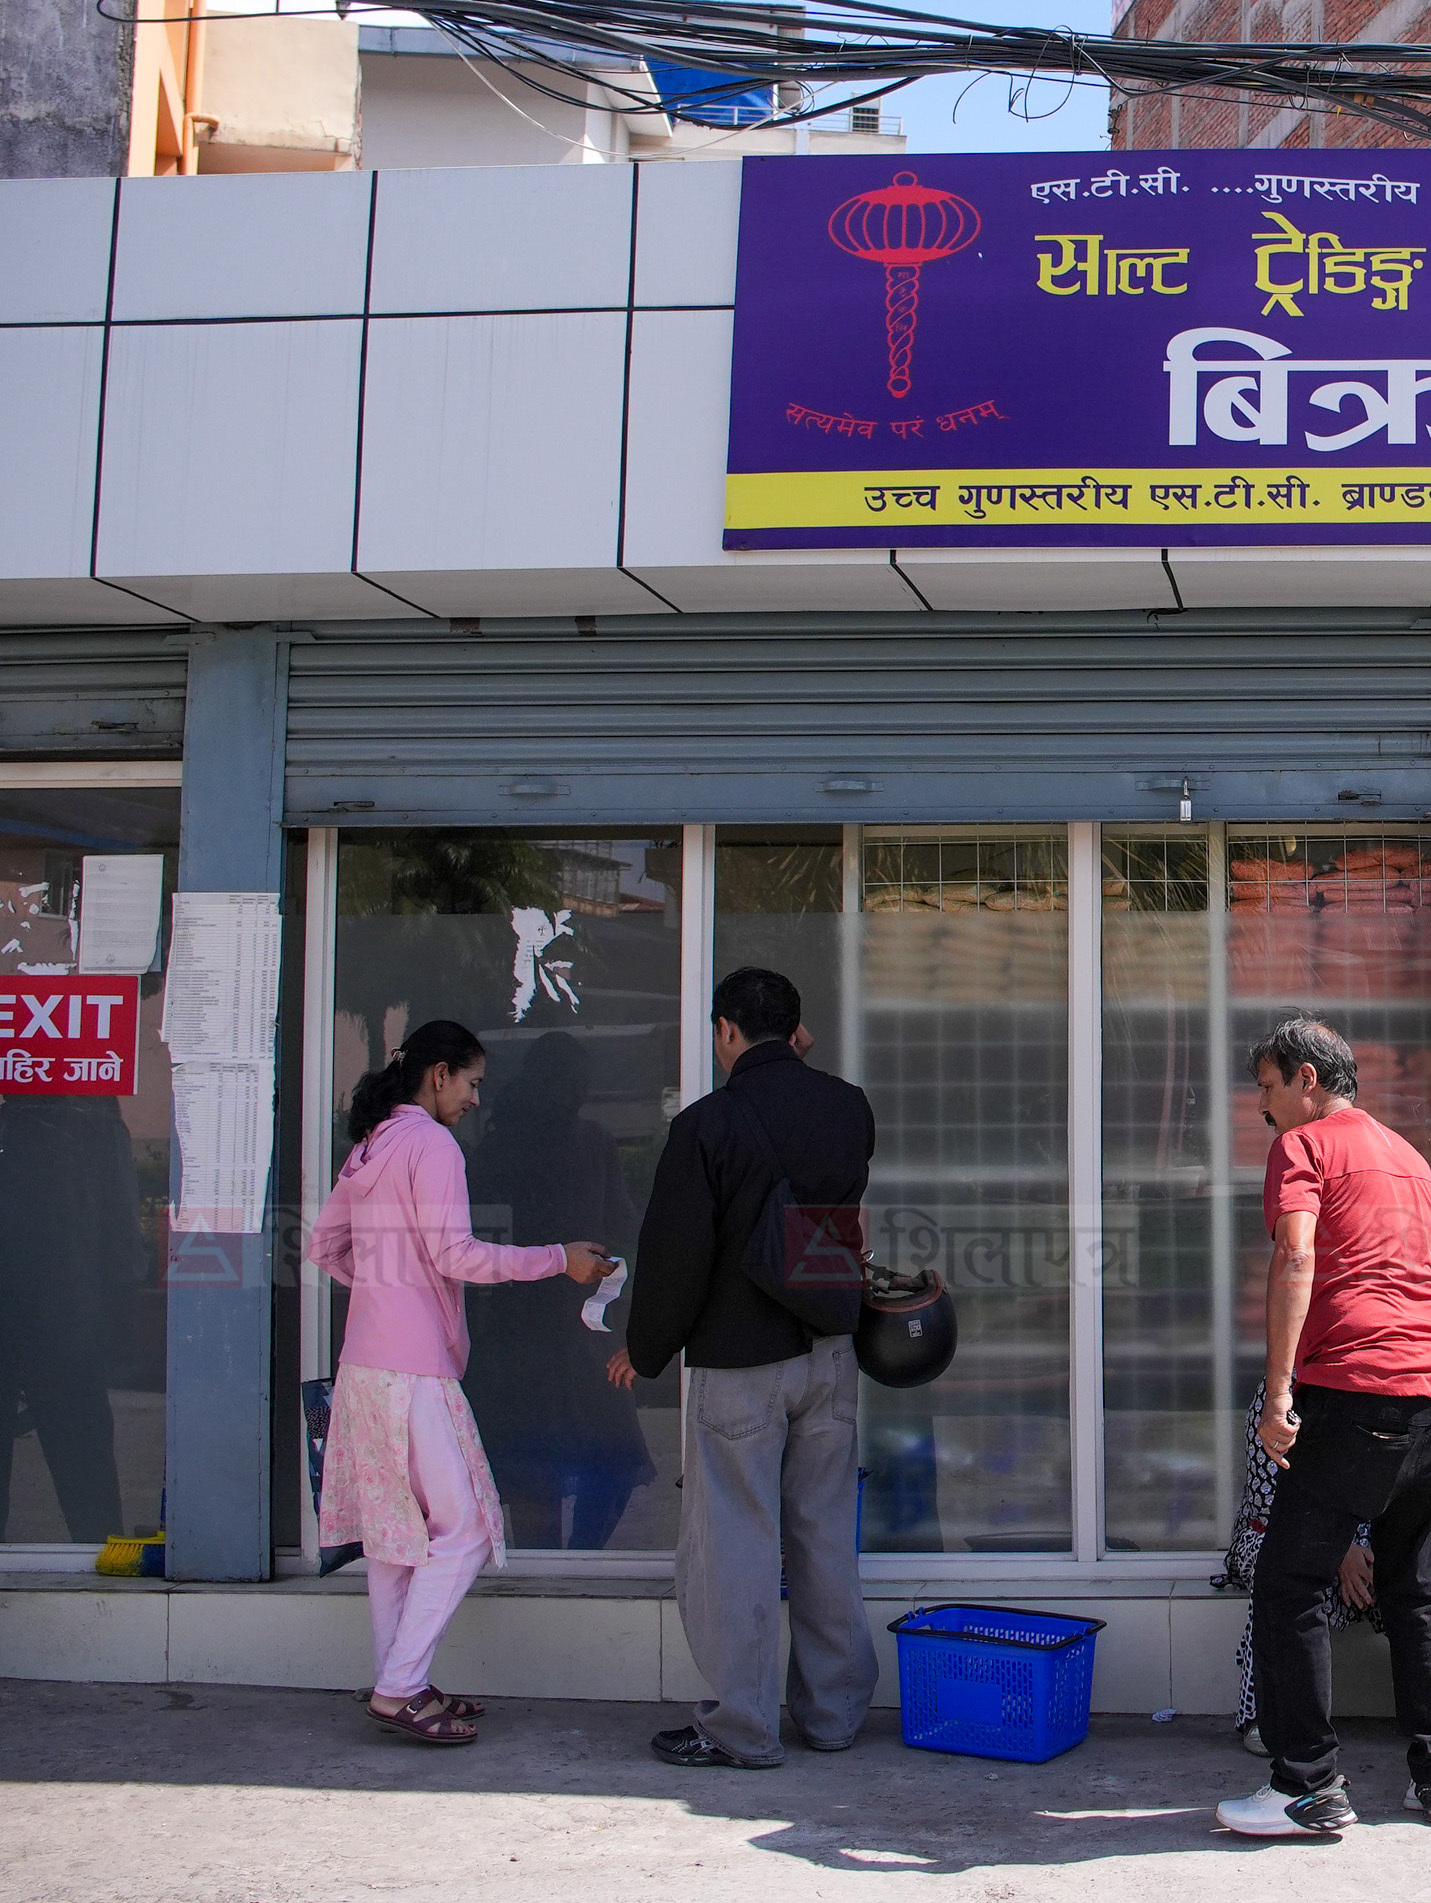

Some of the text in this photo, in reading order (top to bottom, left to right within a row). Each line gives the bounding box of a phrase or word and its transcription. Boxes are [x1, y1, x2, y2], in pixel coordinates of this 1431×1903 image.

[1034, 234, 1190, 296] साल्ट
[785, 400, 1010, 440] सत्यमेव परं धनम्
[864, 484, 940, 512] उच्च
[958, 476, 1132, 519] गुणस्तरीय
[63, 1050, 124, 1081] जाने
